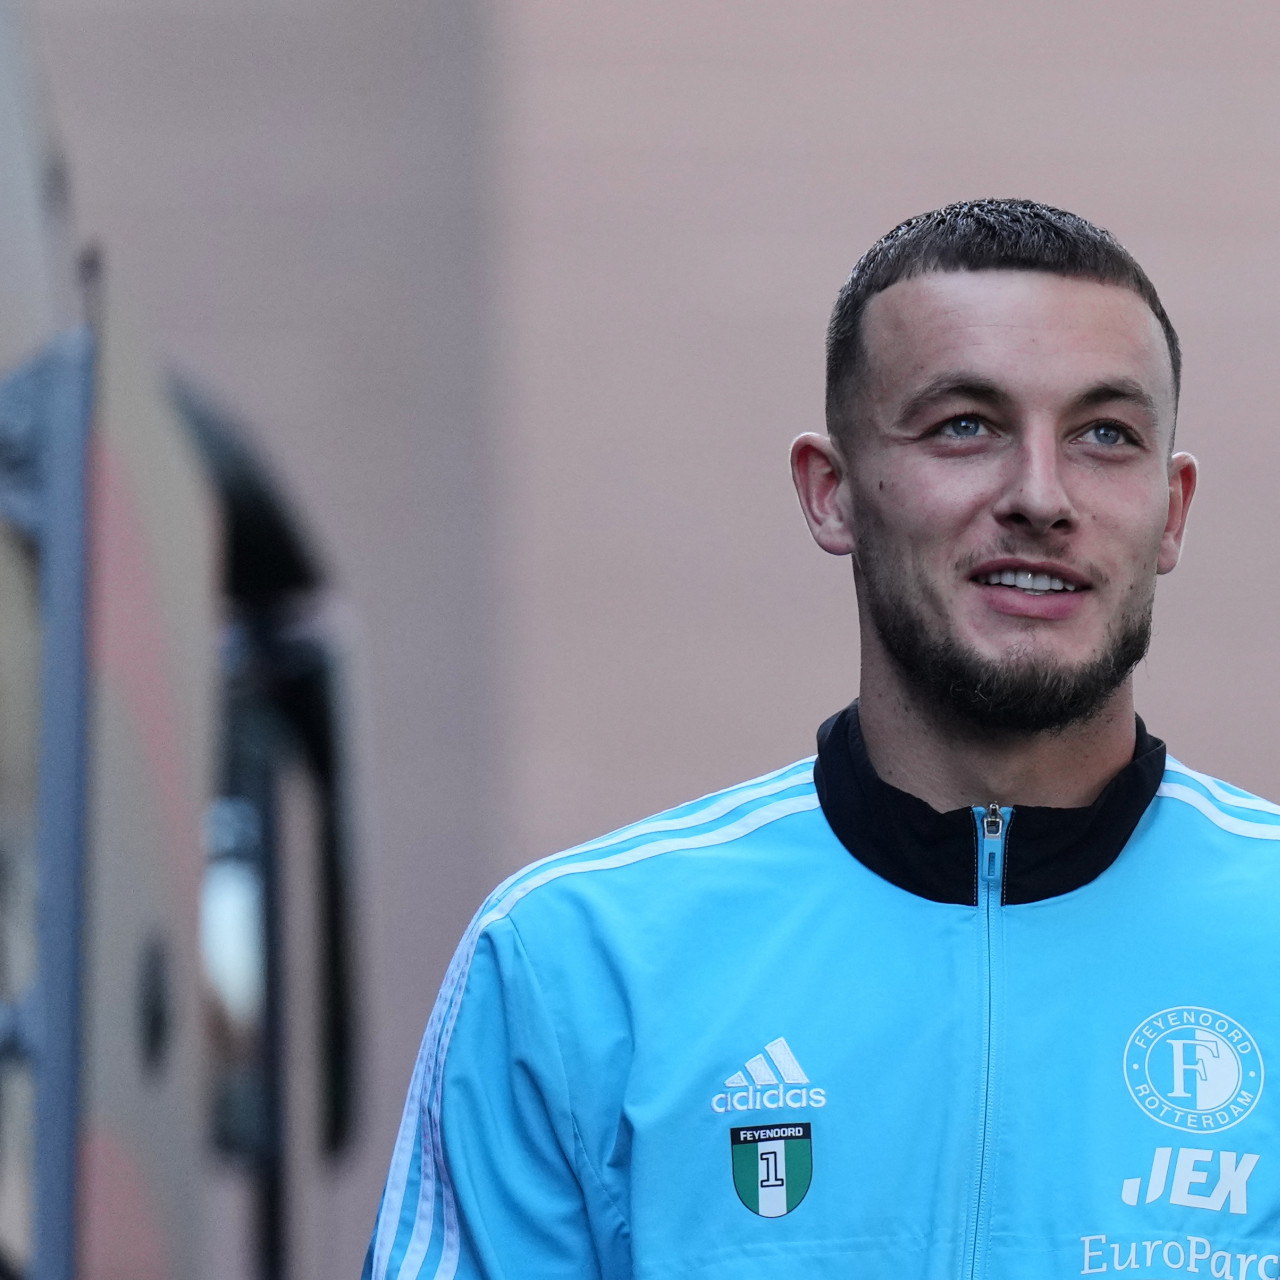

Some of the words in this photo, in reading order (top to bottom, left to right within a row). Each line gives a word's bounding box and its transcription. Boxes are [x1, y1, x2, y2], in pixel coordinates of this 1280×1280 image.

[1134, 1011, 1252, 1055] FEYENOORD
[1166, 1039, 1220, 1098] F
[711, 1084, 826, 1112] adidas
[1135, 1083, 1254, 1129] ROTTERDAM
[740, 1127, 803, 1141] FEYENOORD
[760, 1151, 784, 1187] 1
[1121, 1147, 1260, 1214] JEX
